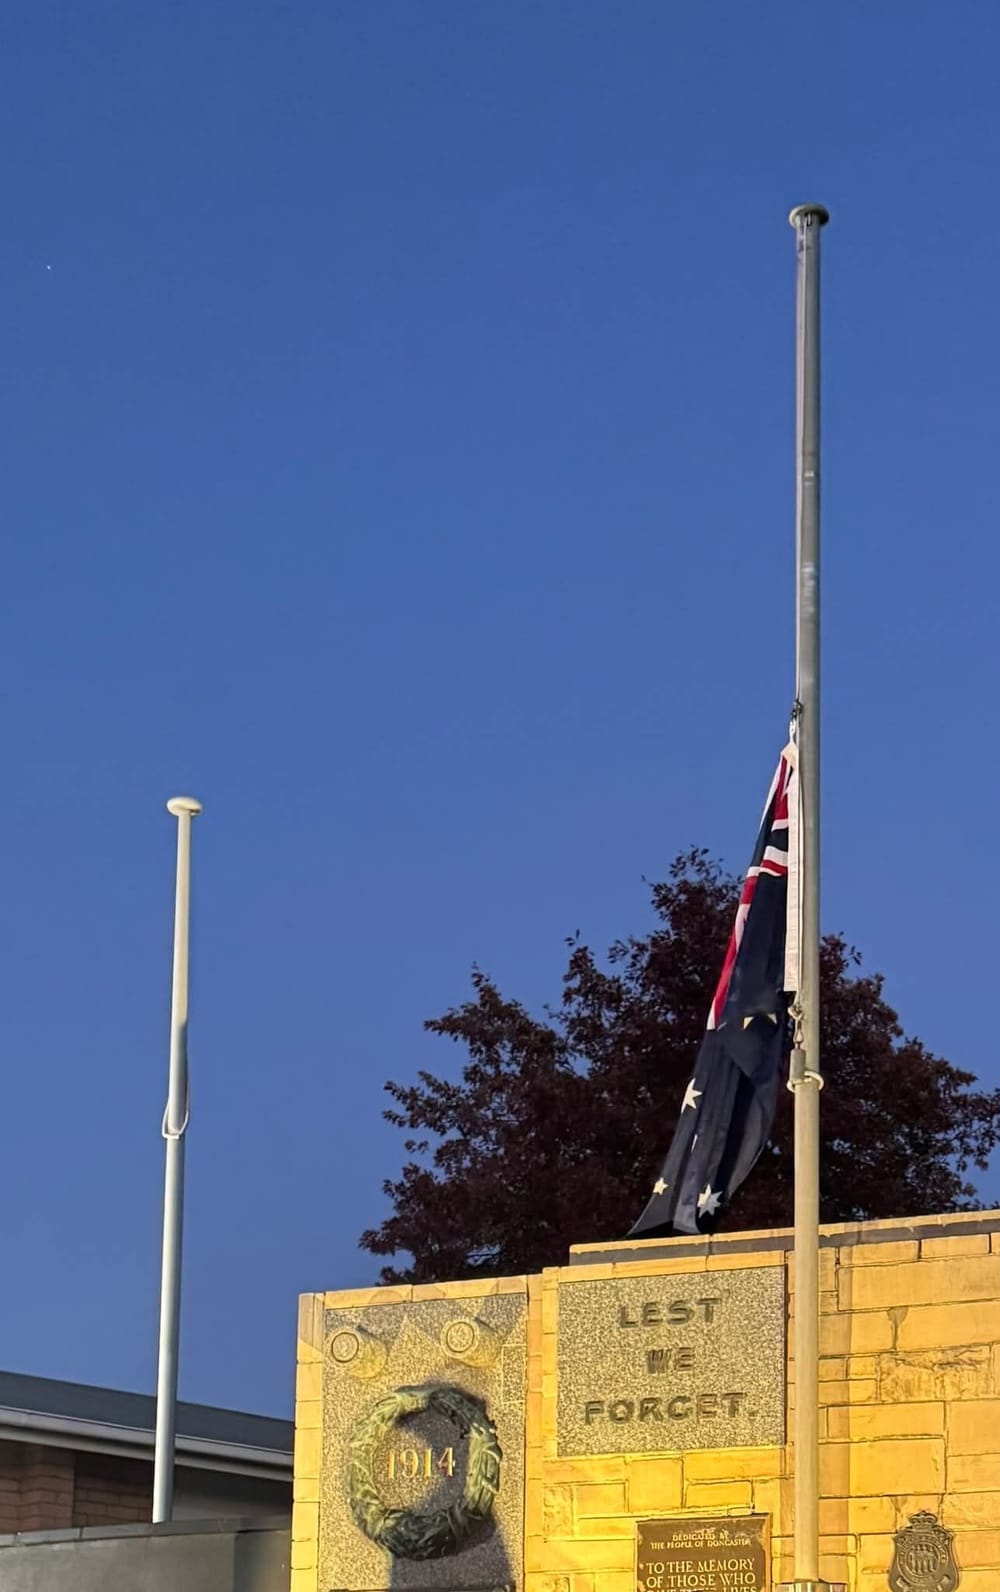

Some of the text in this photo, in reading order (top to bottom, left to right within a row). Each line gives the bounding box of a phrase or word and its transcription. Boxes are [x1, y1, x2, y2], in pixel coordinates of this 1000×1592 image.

[617, 1297, 722, 1328] LEST
[646, 1346, 696, 1375] WE
[387, 1446, 456, 1480] 1914
[650, 1538, 752, 1550] THE PEOPLE OF DONCASTER
[646, 1558, 755, 1575] TO THE MEMORY
[646, 1572, 756, 1588] OF THOSE WHO
